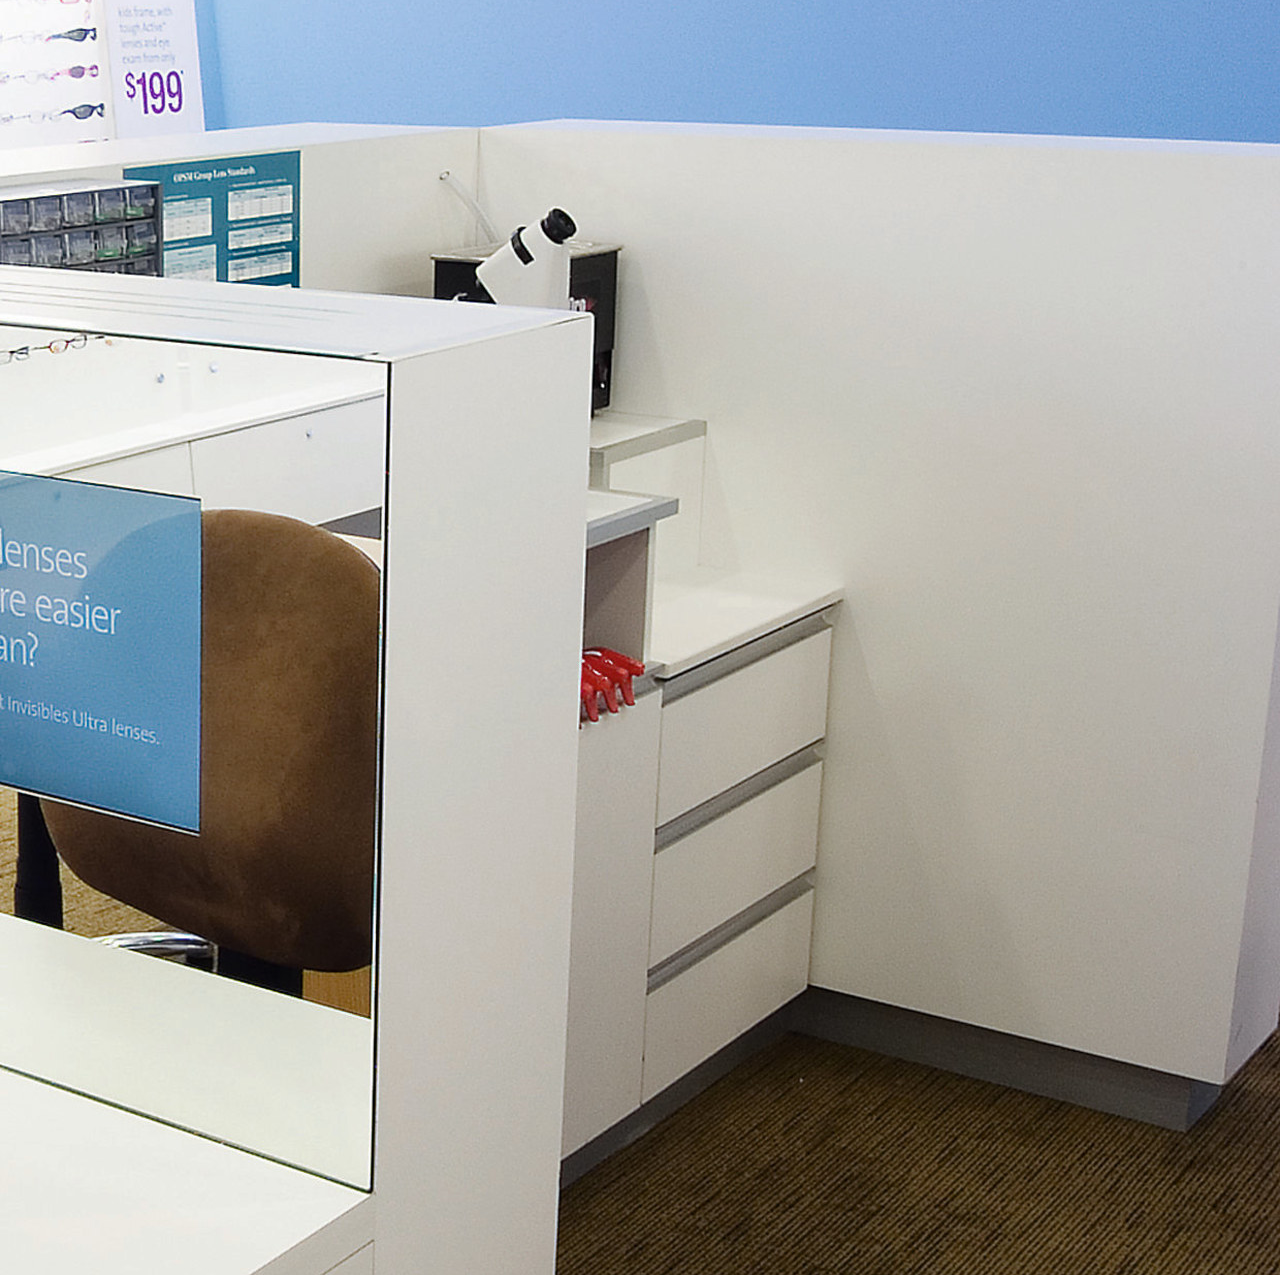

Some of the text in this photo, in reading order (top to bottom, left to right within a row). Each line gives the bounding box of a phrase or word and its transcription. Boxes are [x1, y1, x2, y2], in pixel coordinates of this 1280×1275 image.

[35, 594, 122, 635] easier
[7, 694, 70, 725] Invisibles
[72, 708, 109, 734] Ultra
[111, 716, 161, 746] lenses.
